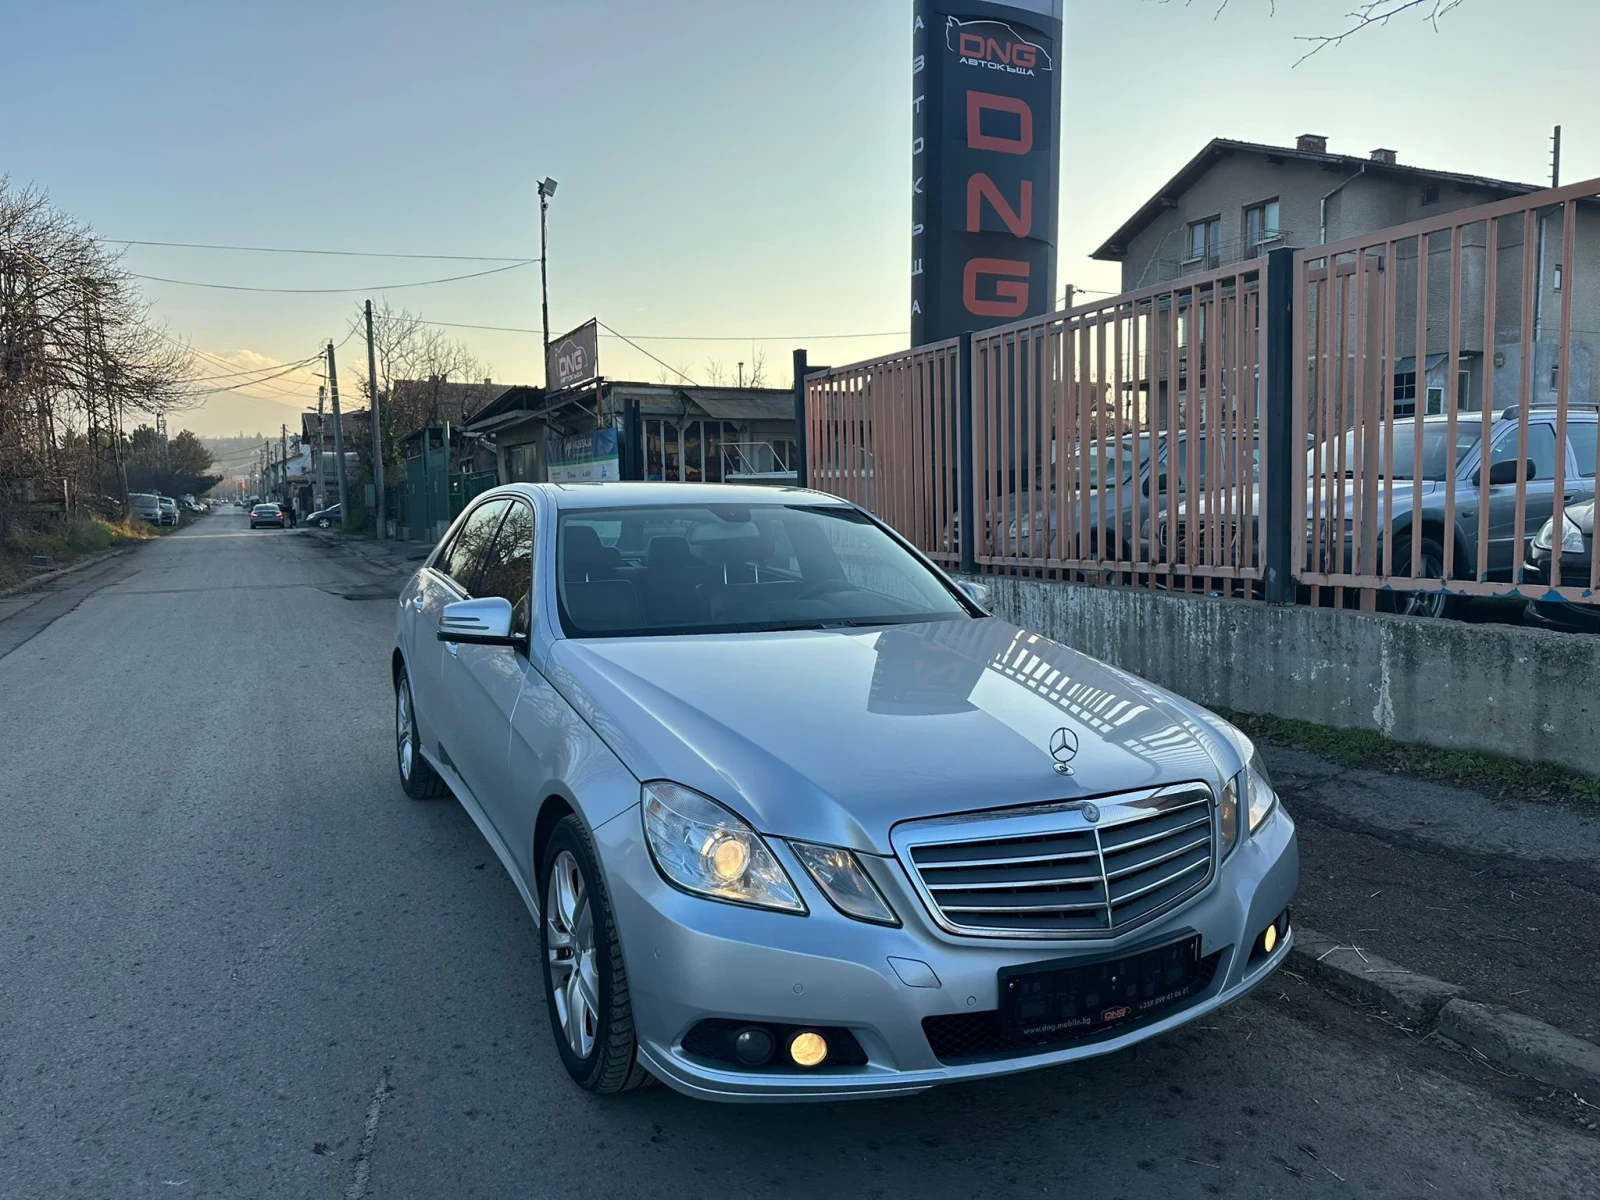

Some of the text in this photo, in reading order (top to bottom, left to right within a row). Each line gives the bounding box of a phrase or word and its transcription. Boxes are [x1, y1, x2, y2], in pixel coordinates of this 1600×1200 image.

[959, 32, 1037, 69] DNG
[963, 89, 1034, 318] DNG
[559, 350, 582, 377] DNG
[1138, 1000, 1155, 1010] +359
[1023, 1017, 1091, 1035] www.dng.mobile.bg
